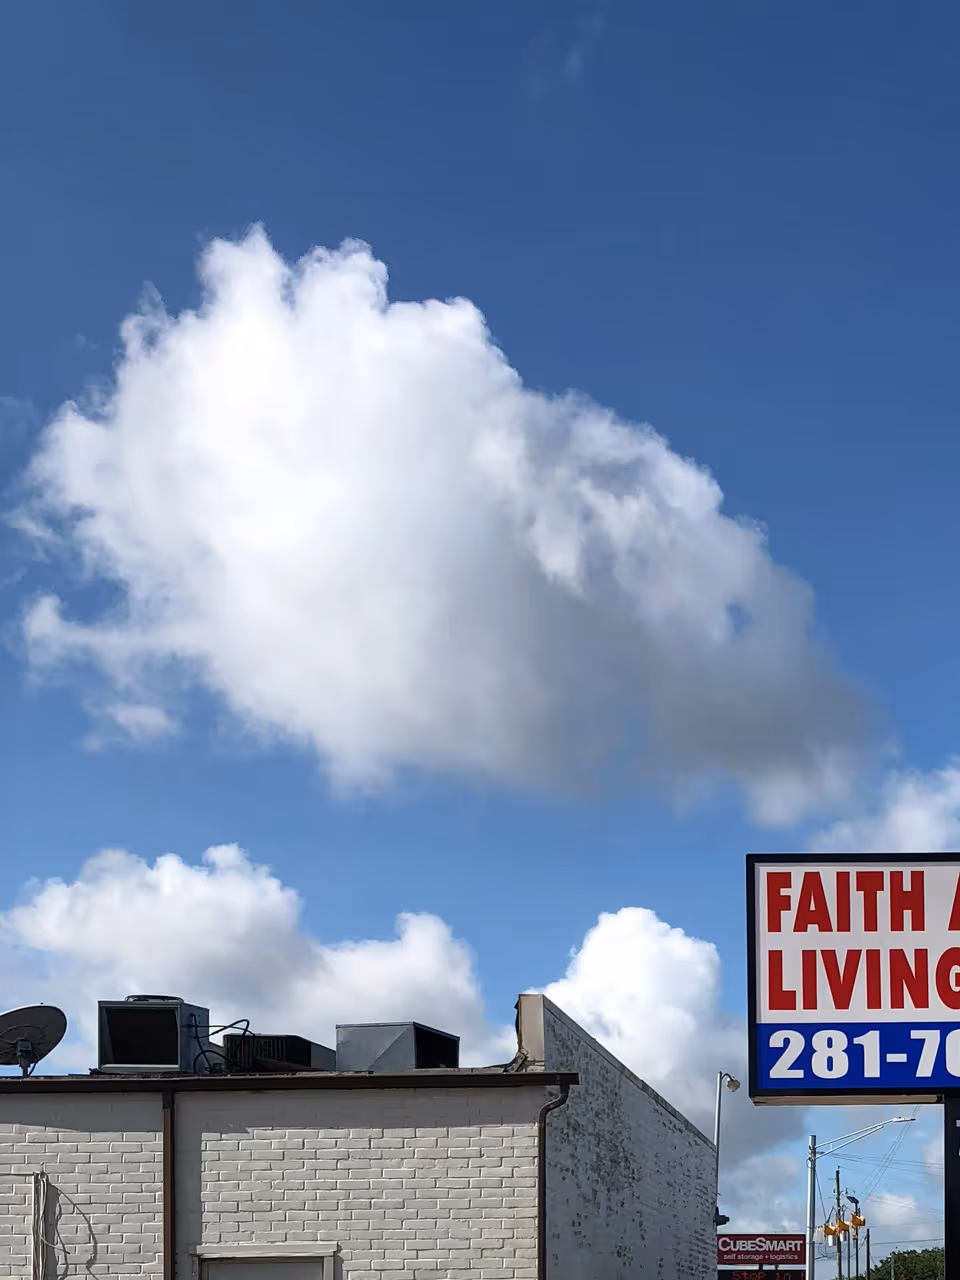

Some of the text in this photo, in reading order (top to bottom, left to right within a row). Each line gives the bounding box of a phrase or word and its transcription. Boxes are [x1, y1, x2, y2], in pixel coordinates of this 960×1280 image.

[766, 870, 925, 933] FAITH
[737, 1253, 763, 1262] storage
[769, 1252, 799, 1262] logistics
